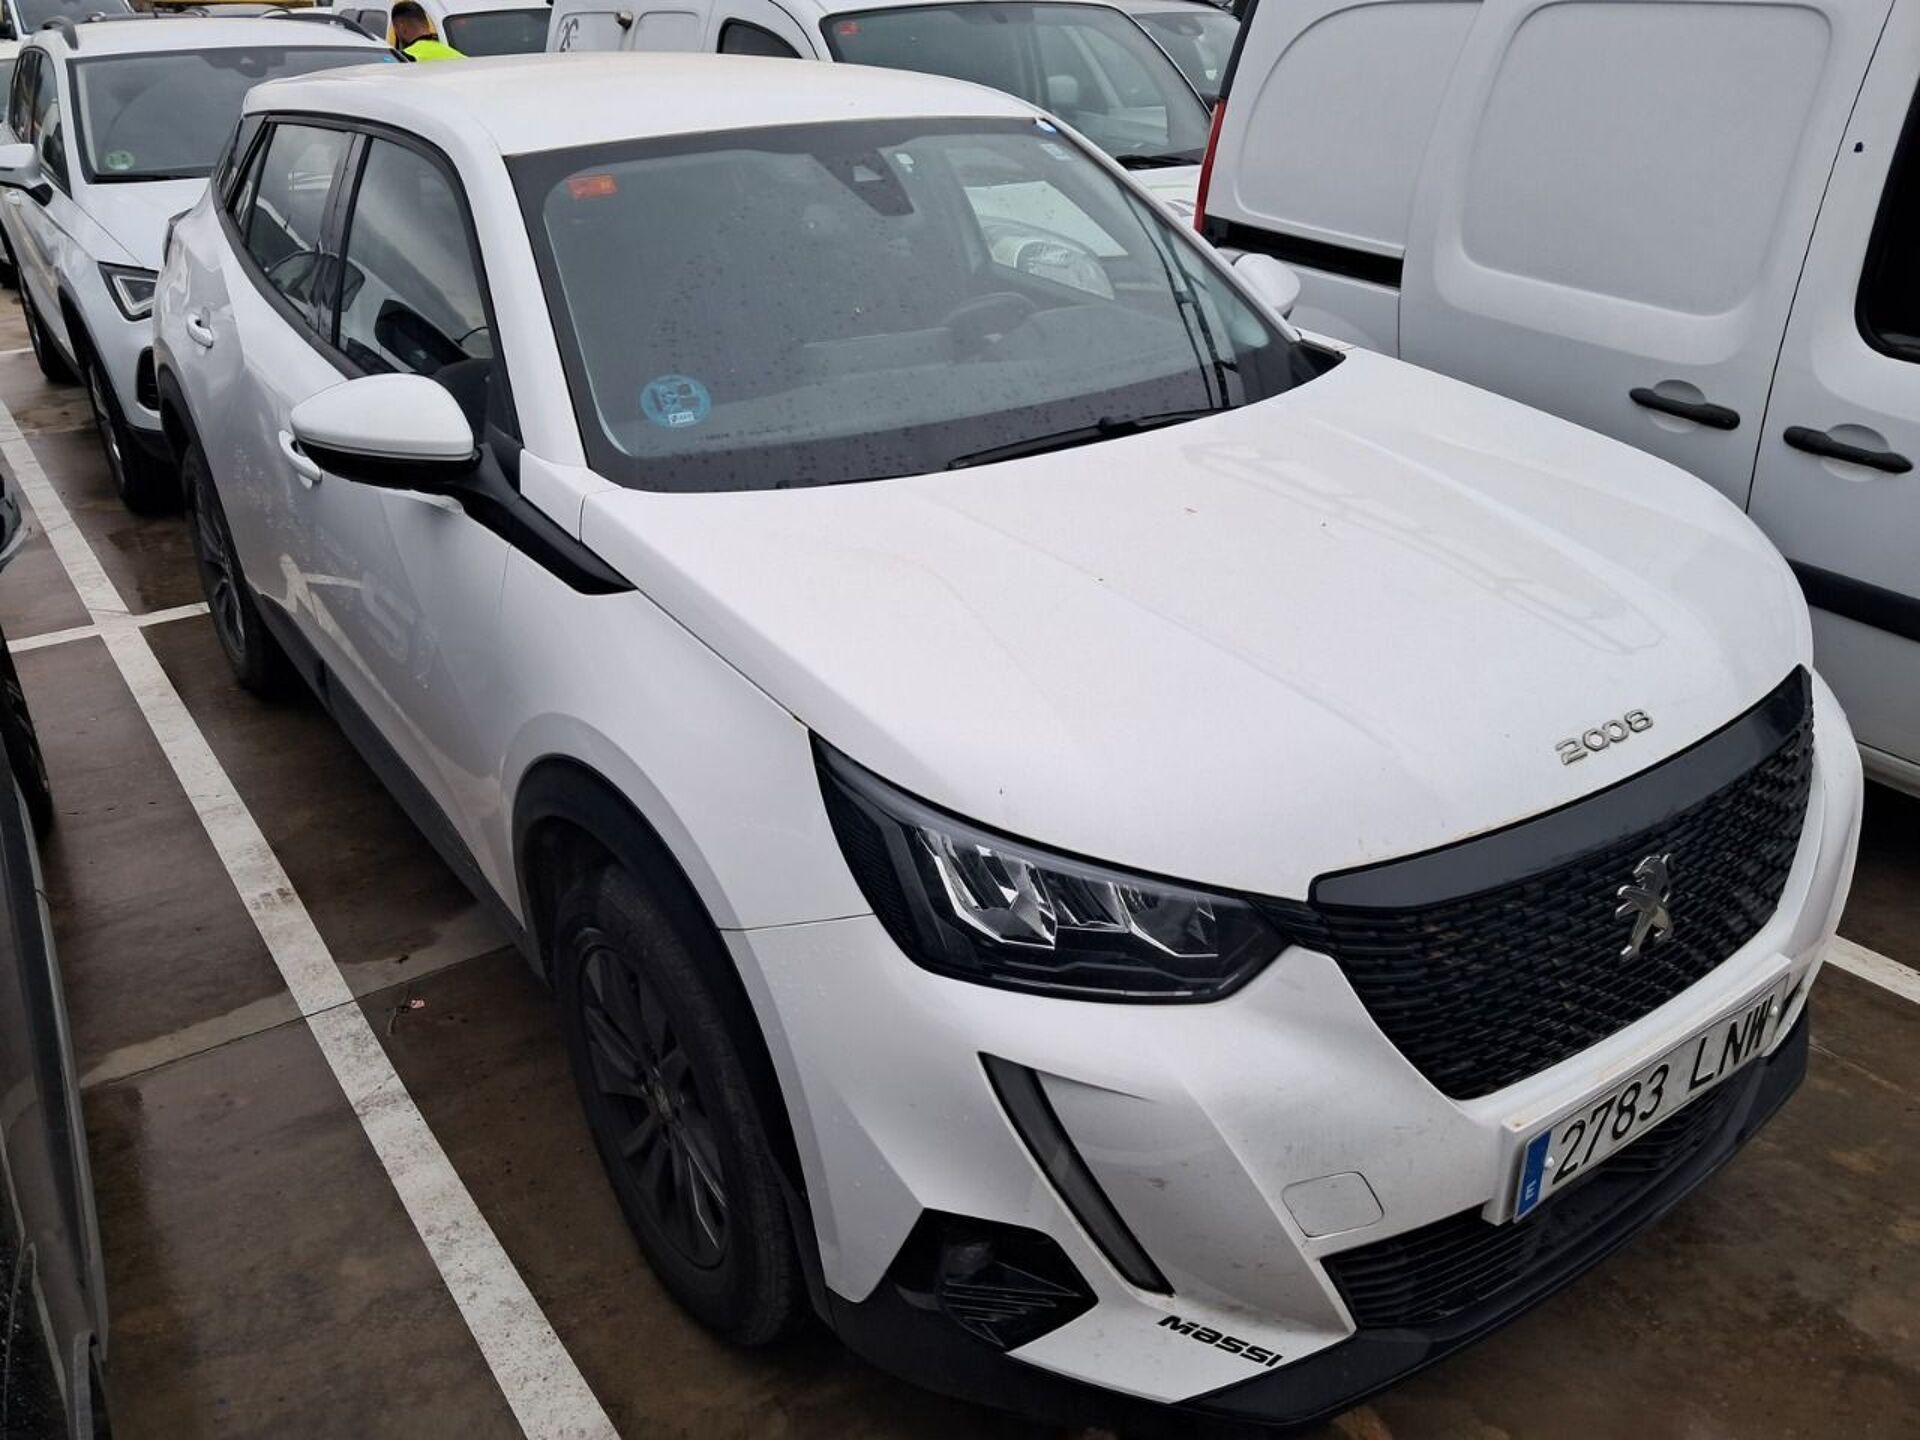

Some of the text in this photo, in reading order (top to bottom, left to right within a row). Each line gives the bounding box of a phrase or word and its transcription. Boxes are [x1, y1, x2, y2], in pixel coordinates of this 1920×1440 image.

[1555, 709, 1653, 765] 2008
[1552, 994, 1774, 1185] 2783 LNW
[1525, 1179, 1537, 1201] E
